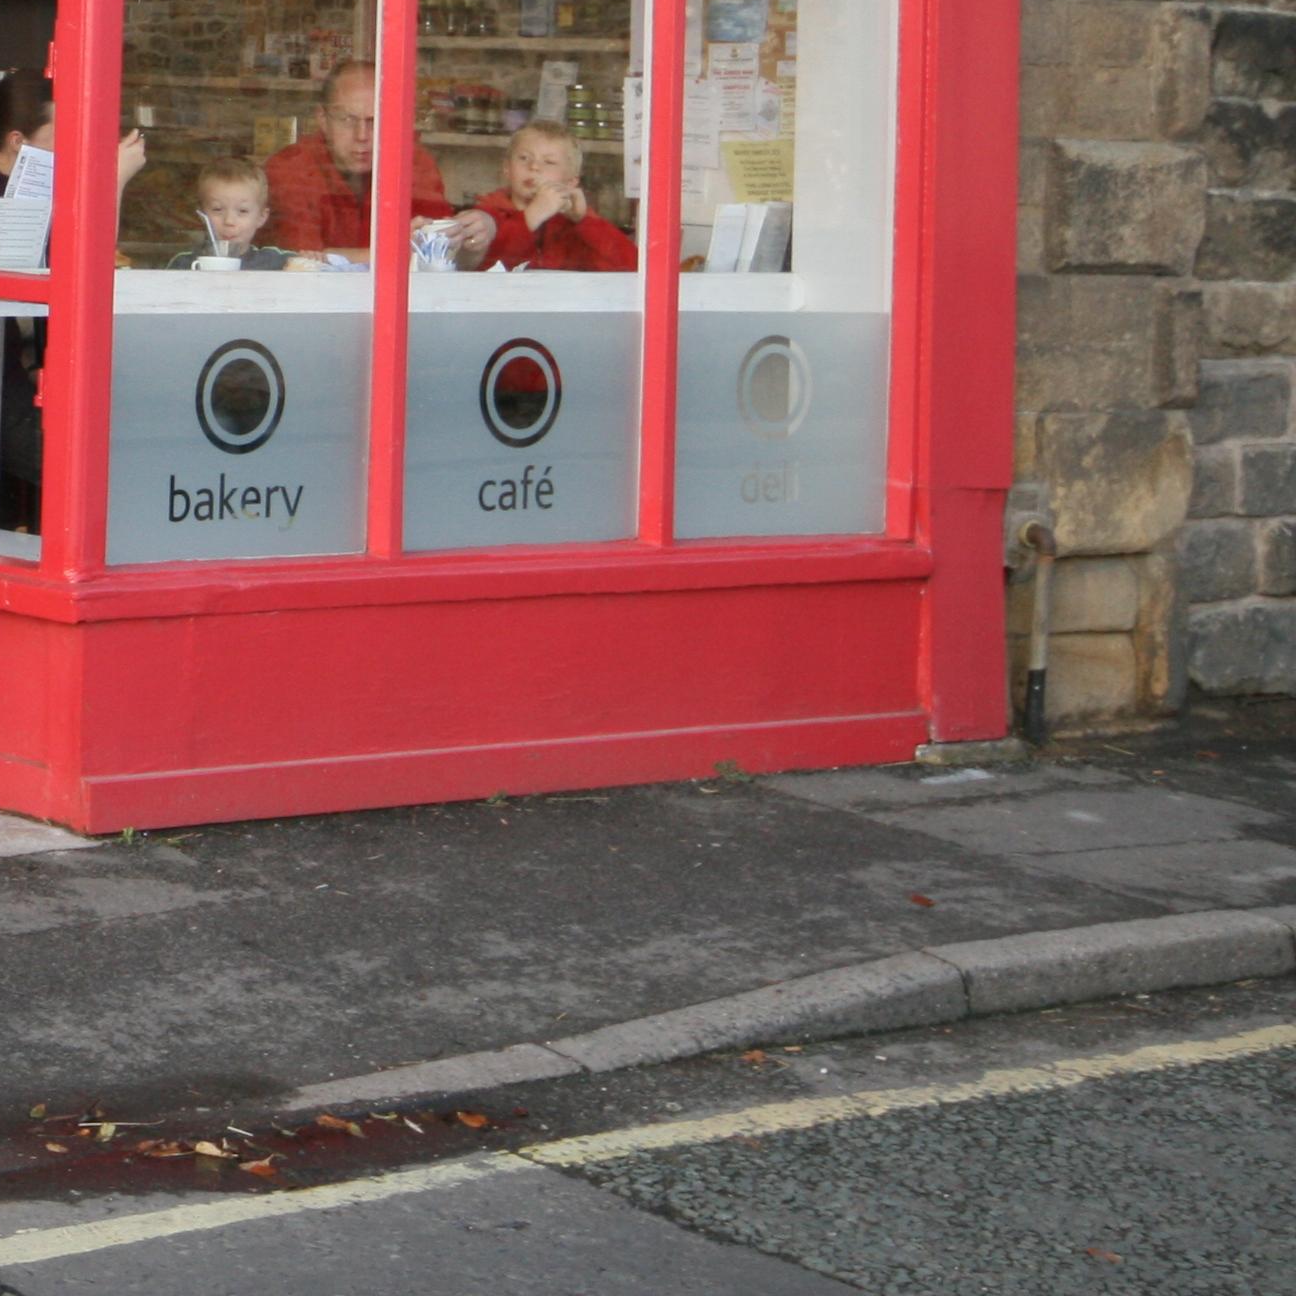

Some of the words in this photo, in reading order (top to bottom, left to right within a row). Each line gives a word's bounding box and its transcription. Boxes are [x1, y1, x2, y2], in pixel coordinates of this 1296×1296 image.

[168, 473, 304, 531] bakery
[478, 466, 555, 512] café
[740, 460, 800, 504] deli
